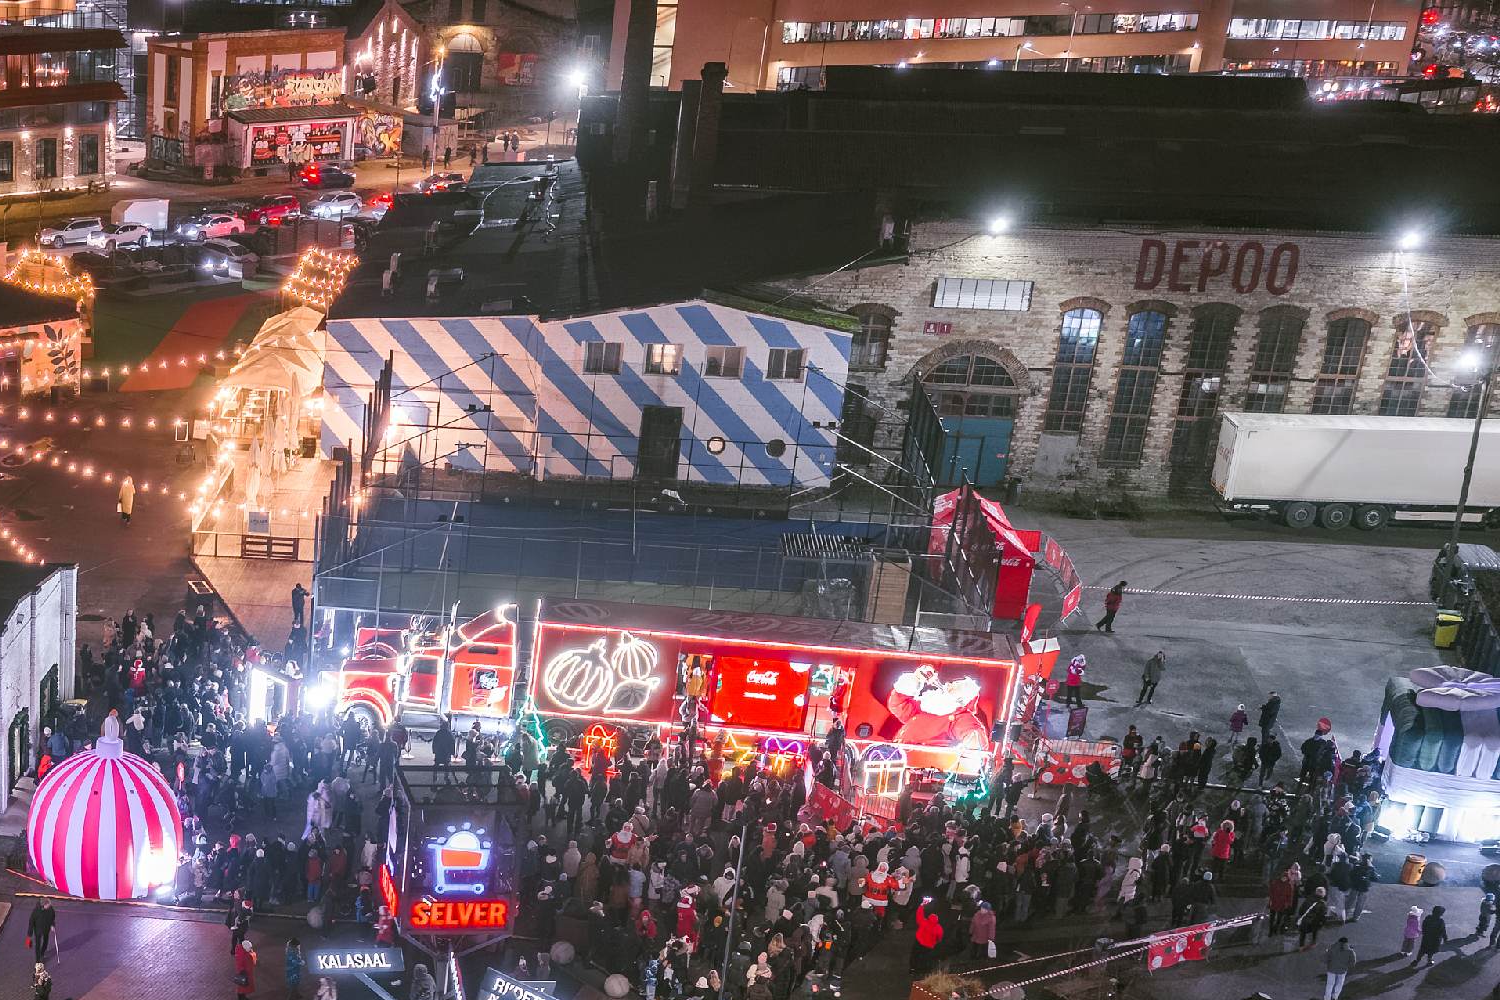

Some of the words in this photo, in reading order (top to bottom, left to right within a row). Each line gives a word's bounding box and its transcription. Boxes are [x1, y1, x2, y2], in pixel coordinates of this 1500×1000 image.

[1133, 238, 1301, 296] DEPOO
[411, 902, 507, 928] SELVER
[317, 952, 392, 970] KALASAAL
